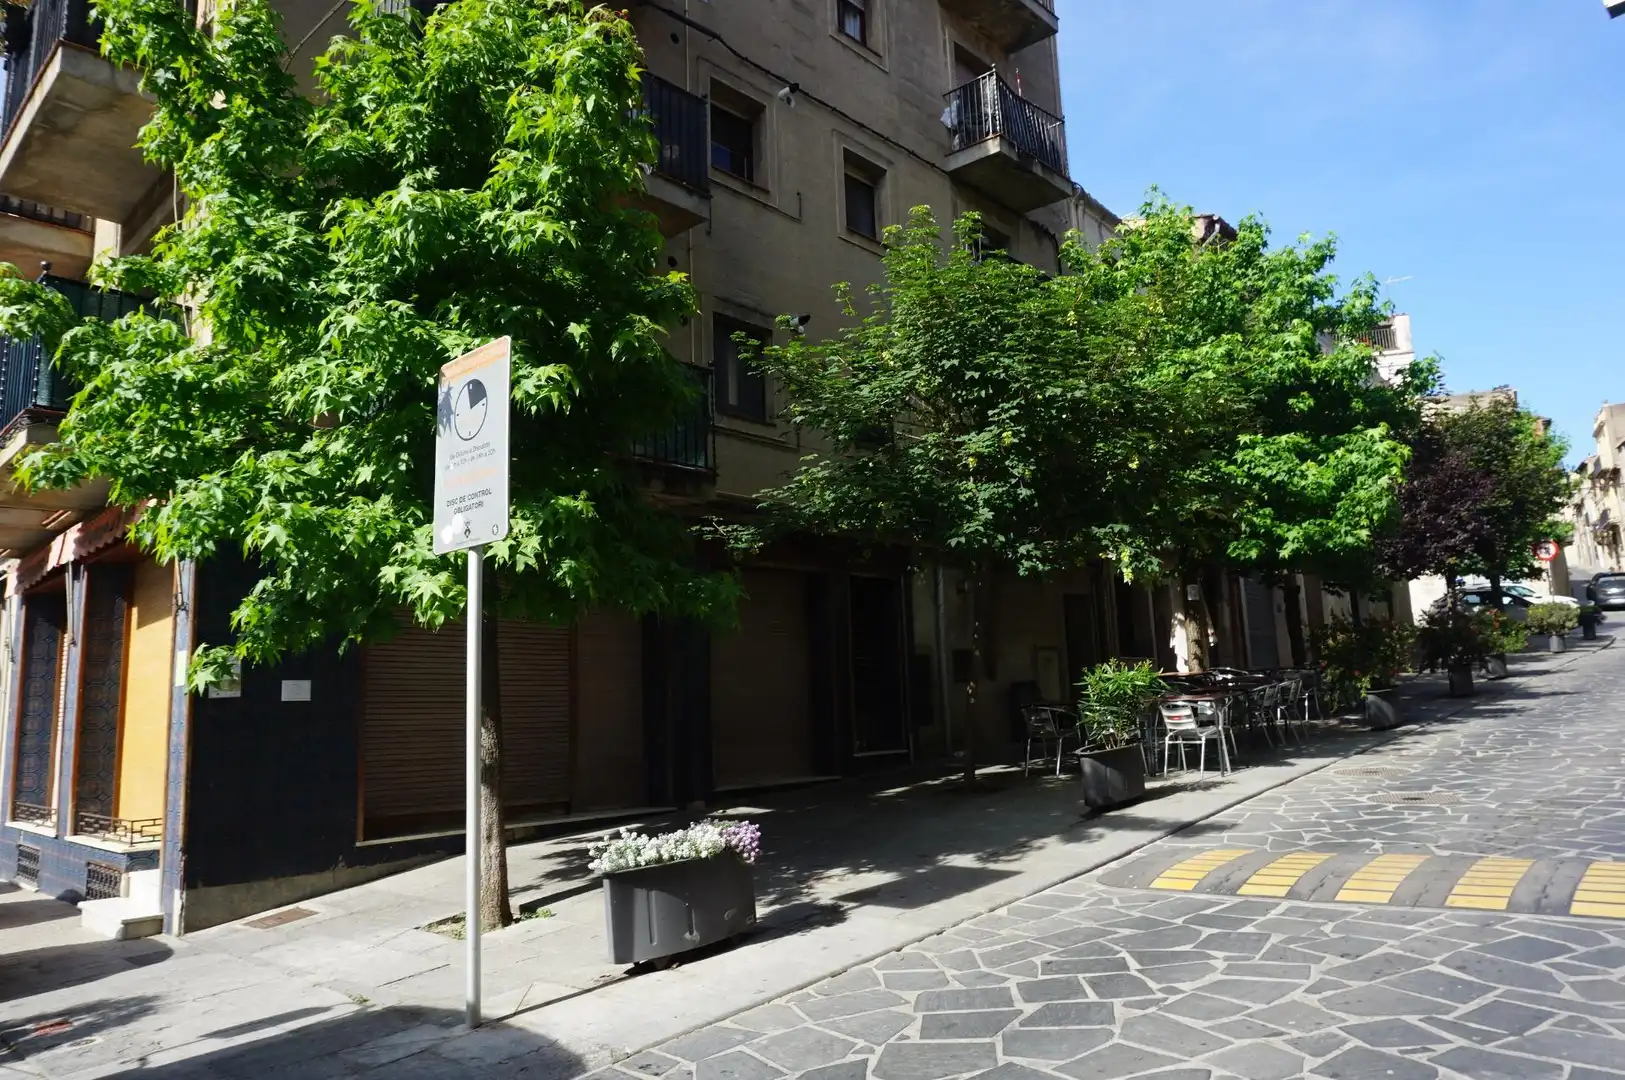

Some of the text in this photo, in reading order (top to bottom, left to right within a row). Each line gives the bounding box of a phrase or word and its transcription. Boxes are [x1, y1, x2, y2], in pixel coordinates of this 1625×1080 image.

[447, 487, 492, 507] DISC DE CONTROL
[454, 500, 484, 515] OBLIGATORI
